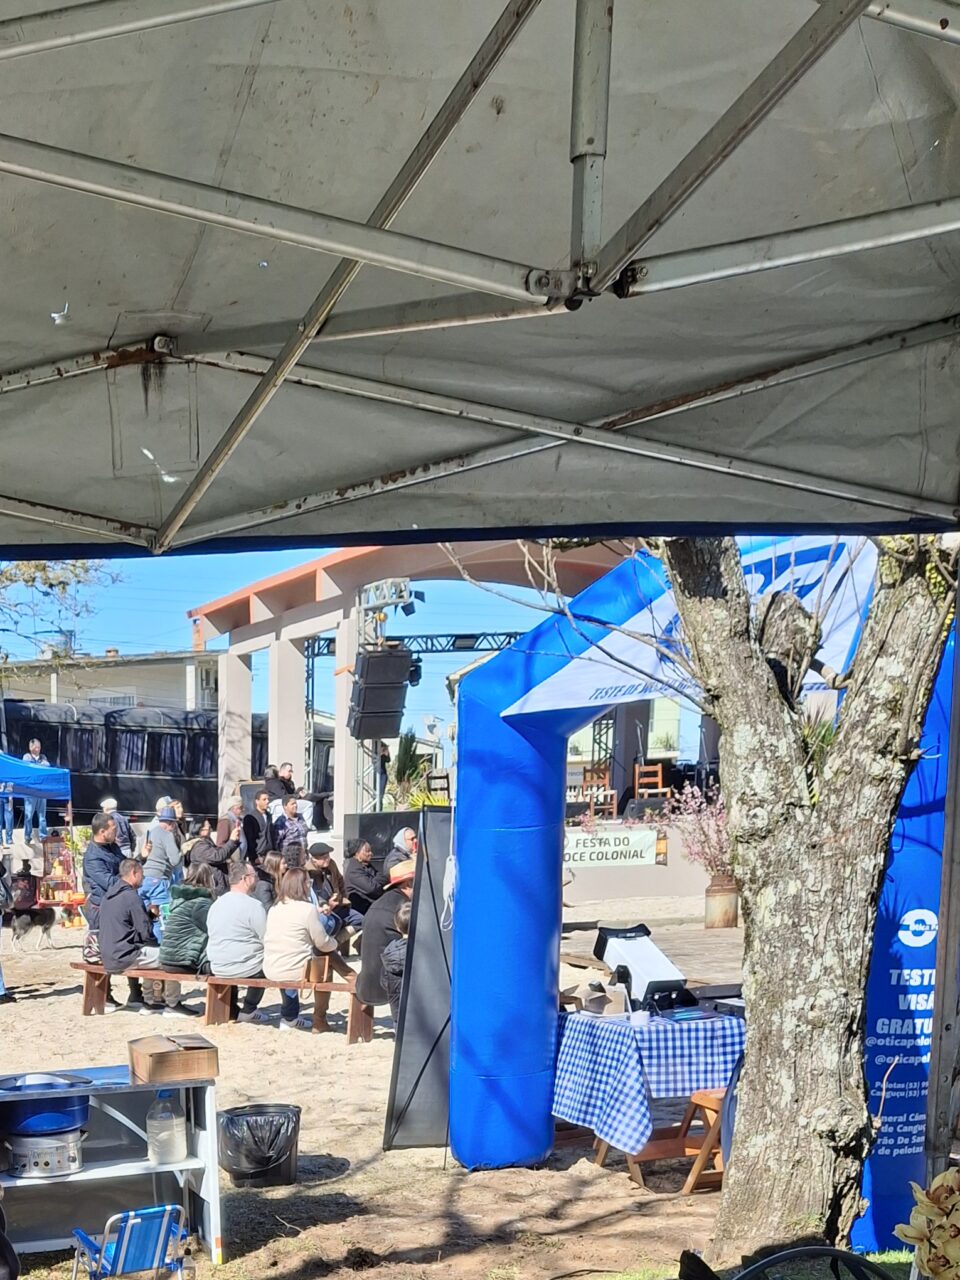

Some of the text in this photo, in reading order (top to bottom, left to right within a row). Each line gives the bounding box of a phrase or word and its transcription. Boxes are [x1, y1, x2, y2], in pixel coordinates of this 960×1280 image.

[576, 837, 630, 848] FESTA DO
[563, 850, 646, 862] OCE COLONIAL
[876, 1018, 933, 1034] GRATU
[865, 1035, 932, 1048] @oticapelo
[875, 1052, 931, 1066] @oticapel
[877, 1136, 895, 1145] rão
